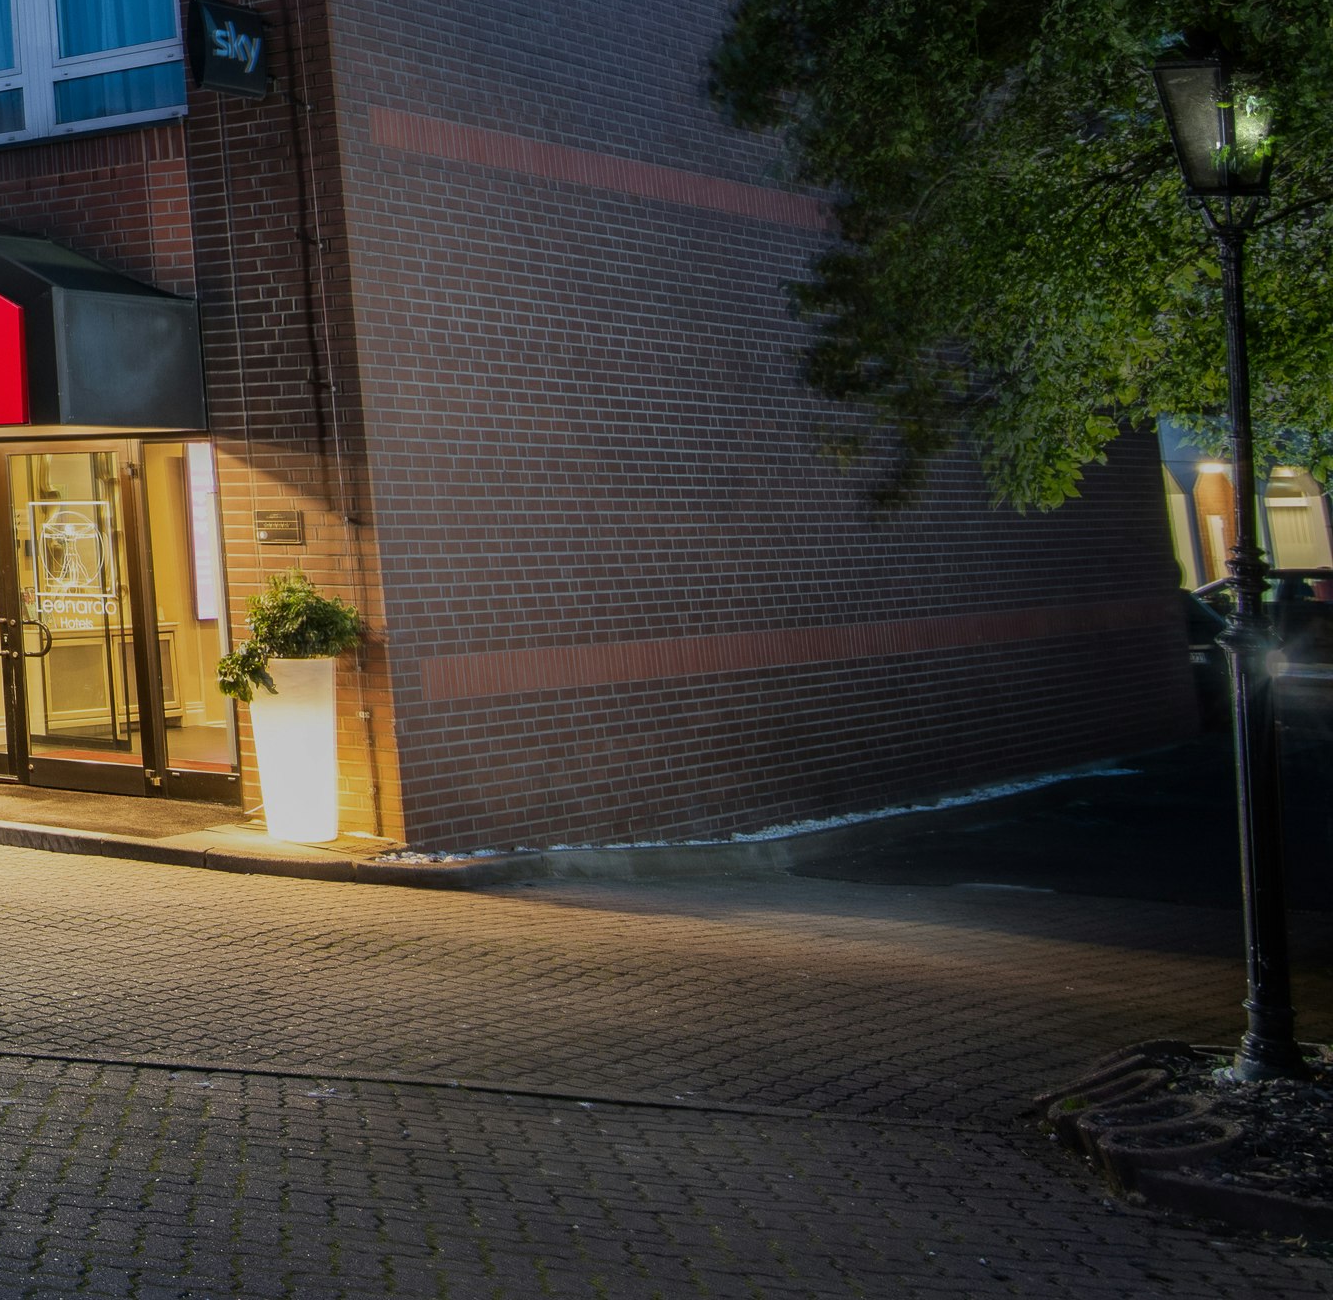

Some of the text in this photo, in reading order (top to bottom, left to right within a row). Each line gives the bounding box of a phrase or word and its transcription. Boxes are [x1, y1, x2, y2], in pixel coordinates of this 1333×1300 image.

[212, 20, 262, 74] sky
[36, 596, 118, 615] Leonardo
[61, 615, 93, 629] Hotels
